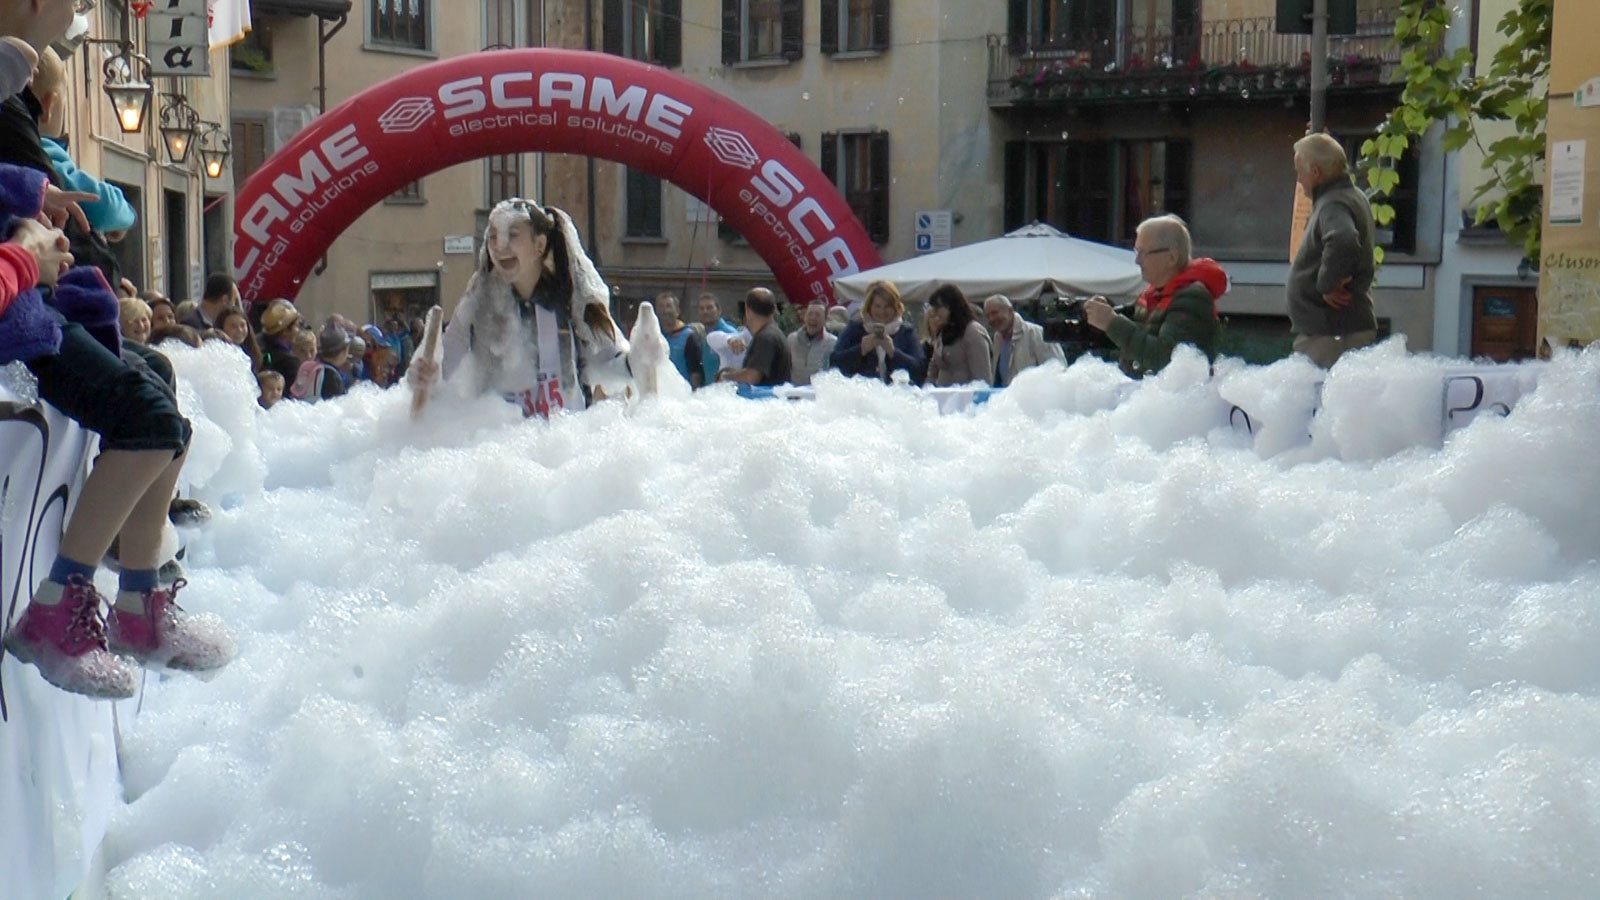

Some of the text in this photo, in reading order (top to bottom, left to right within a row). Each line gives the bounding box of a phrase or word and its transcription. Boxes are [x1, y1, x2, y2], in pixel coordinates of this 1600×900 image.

[438, 72, 693, 138] SCAME
[449, 111, 673, 155] electrical solutions
[233, 123, 369, 281] CAME
[289, 160, 379, 233] solutions
[739, 188, 816, 274] electrical
[750, 159, 859, 287] SCA
